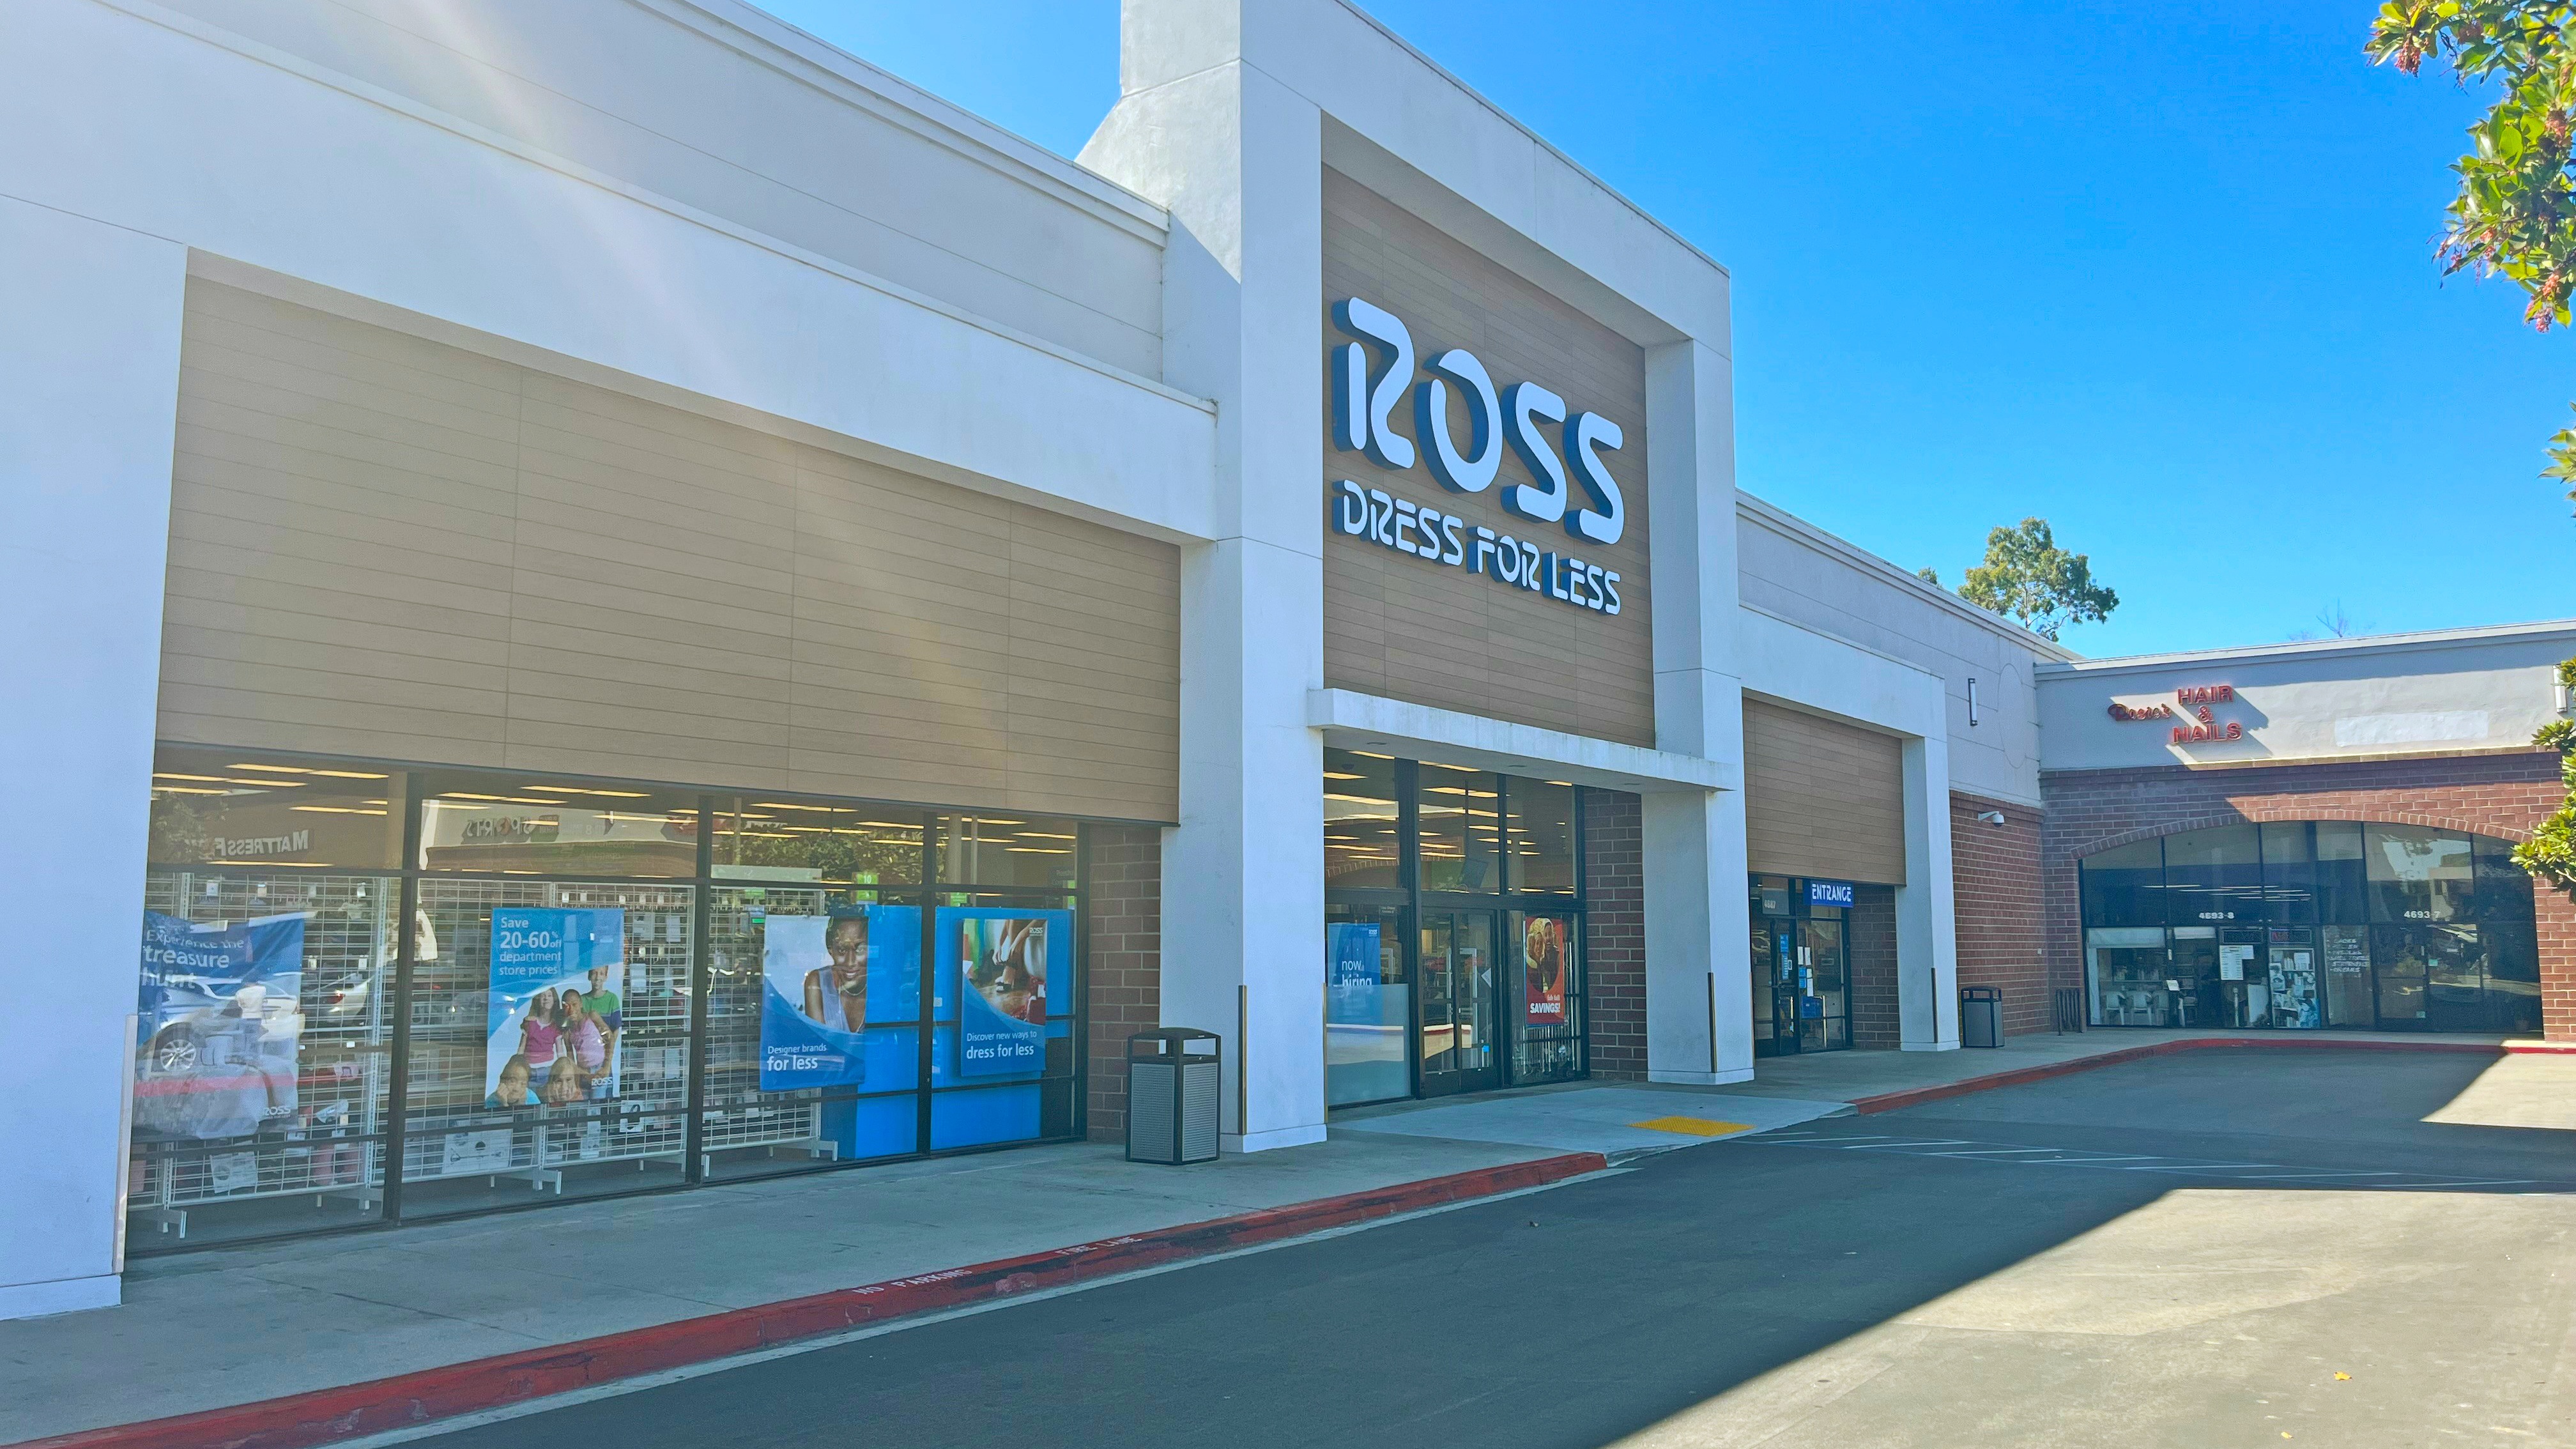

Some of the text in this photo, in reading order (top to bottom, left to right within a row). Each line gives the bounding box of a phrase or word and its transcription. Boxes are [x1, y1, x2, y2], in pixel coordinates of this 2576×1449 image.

[1344, 296, 1625, 544] ROSS
[1340, 480, 1621, 616] DRESS FOR LESS
[2177, 685, 2234, 705] HAIR
[2108, 703, 2172, 721] Rosie's
[2198, 705, 2214, 723] &
[2172, 723, 2242, 744] NAILS
[1812, 884, 1851, 902] ENTRANCE
[500, 917, 529, 928] Save
[146, 929, 244, 949] Experience the
[142, 944, 230, 969] treasure
[499, 951, 562, 964] department
[499, 965, 558, 977] store prices
[1342, 960, 1362, 971] now
[1529, 1002, 1561, 1014] SAVINGS!
[967, 1032, 995, 1042] Discover
[1011, 1032, 1029, 1040] ways
[767, 1043, 827, 1055] Designer brands
[966, 1043, 1034, 1059] dress for less
[767, 1054, 818, 1071] for less
[591, 1077, 613, 1086] ROSS
[852, 1286, 885, 1295] NO
[891, 1269, 972, 1287] PARKING
